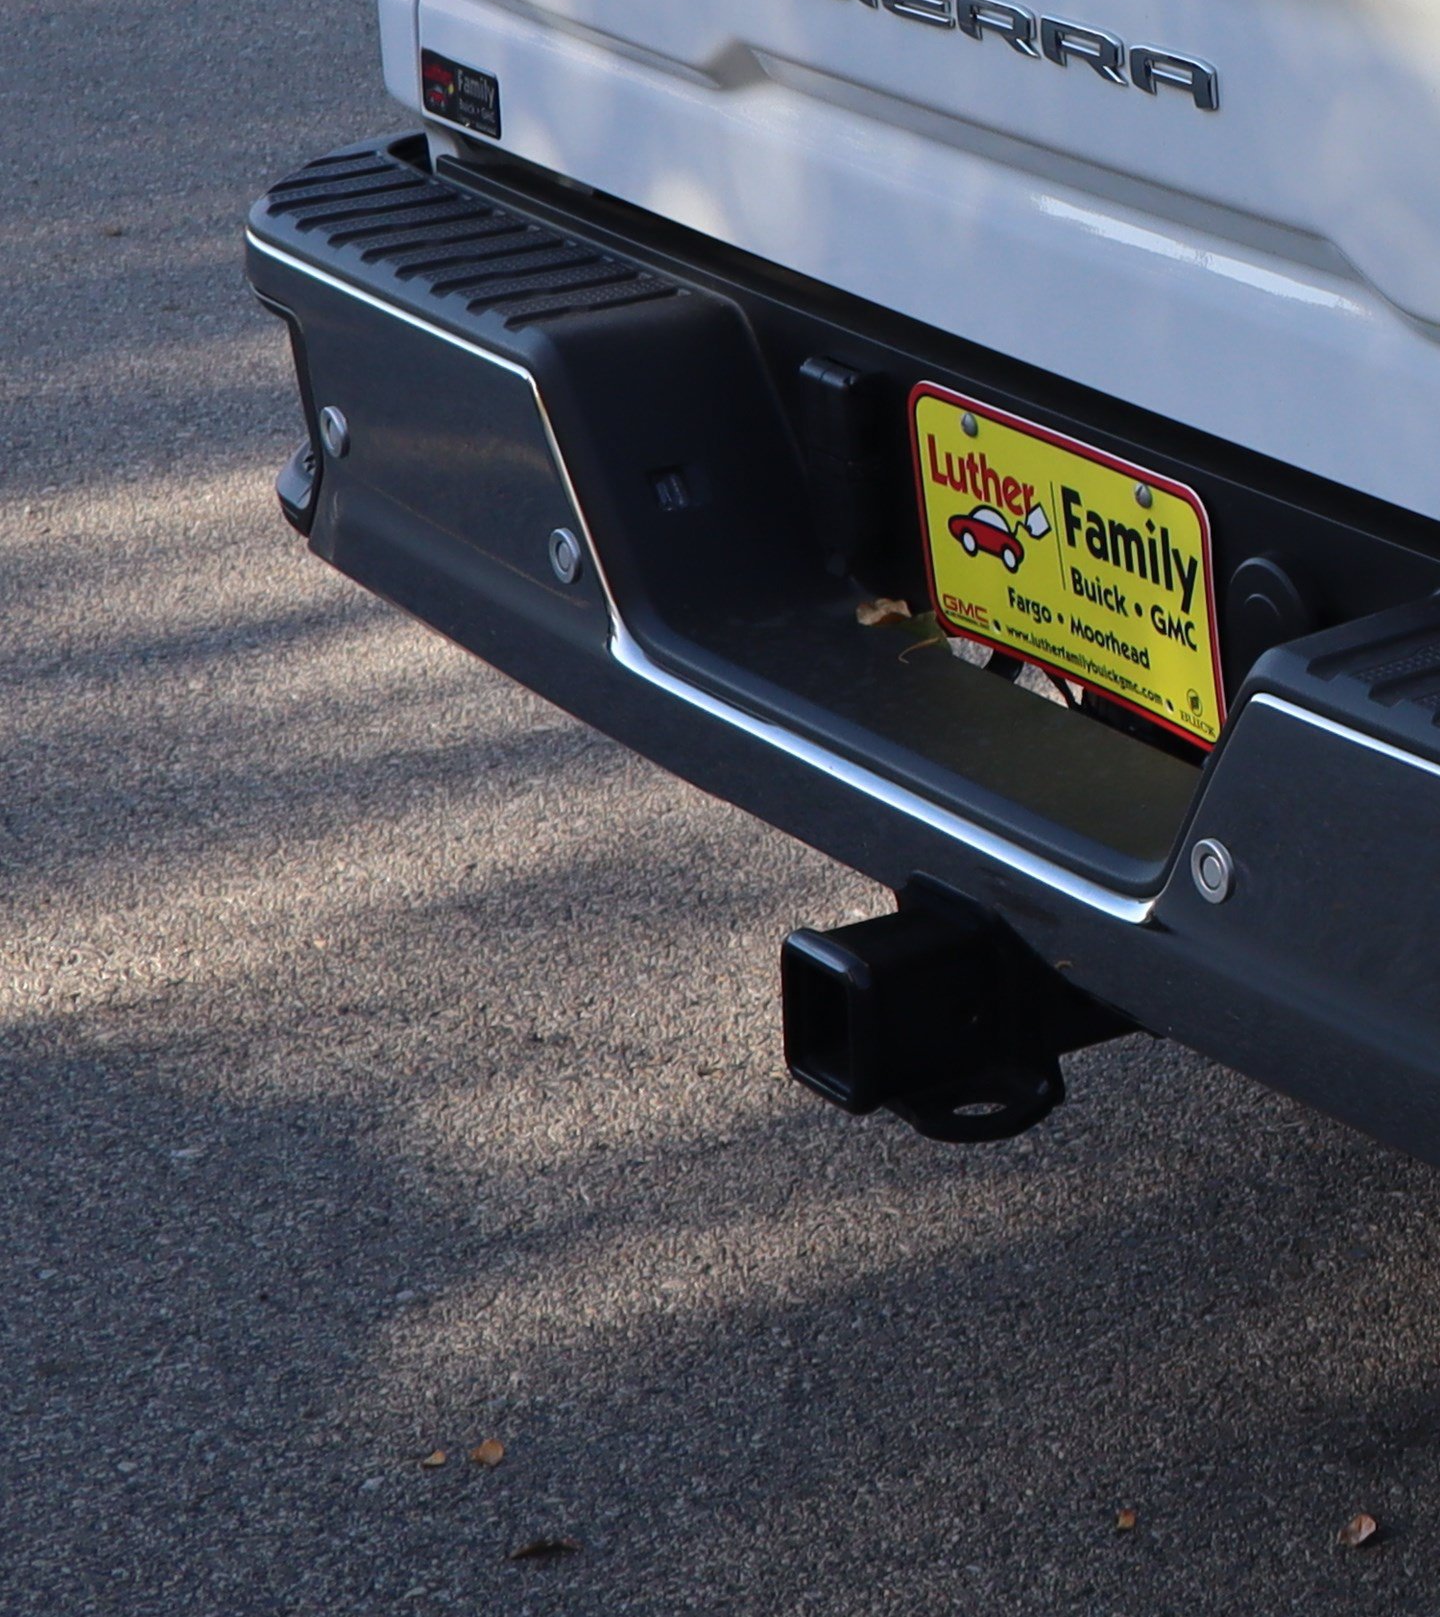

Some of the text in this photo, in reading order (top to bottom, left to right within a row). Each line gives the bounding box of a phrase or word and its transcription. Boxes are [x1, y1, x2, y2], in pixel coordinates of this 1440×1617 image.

[927, 433, 1034, 516] Luther
[1060, 484, 1198, 615] Family
[943, 593, 989, 624] GMC
[1007, 586, 1052, 625] Fargo
[1070, 615, 1151, 670] Moorhead
[1070, 565, 1198, 652] Buick GMC
[1006, 624, 1163, 706] www.lutherfamilybuickgmc.com
[1180, 709, 1217, 739] BUICK
